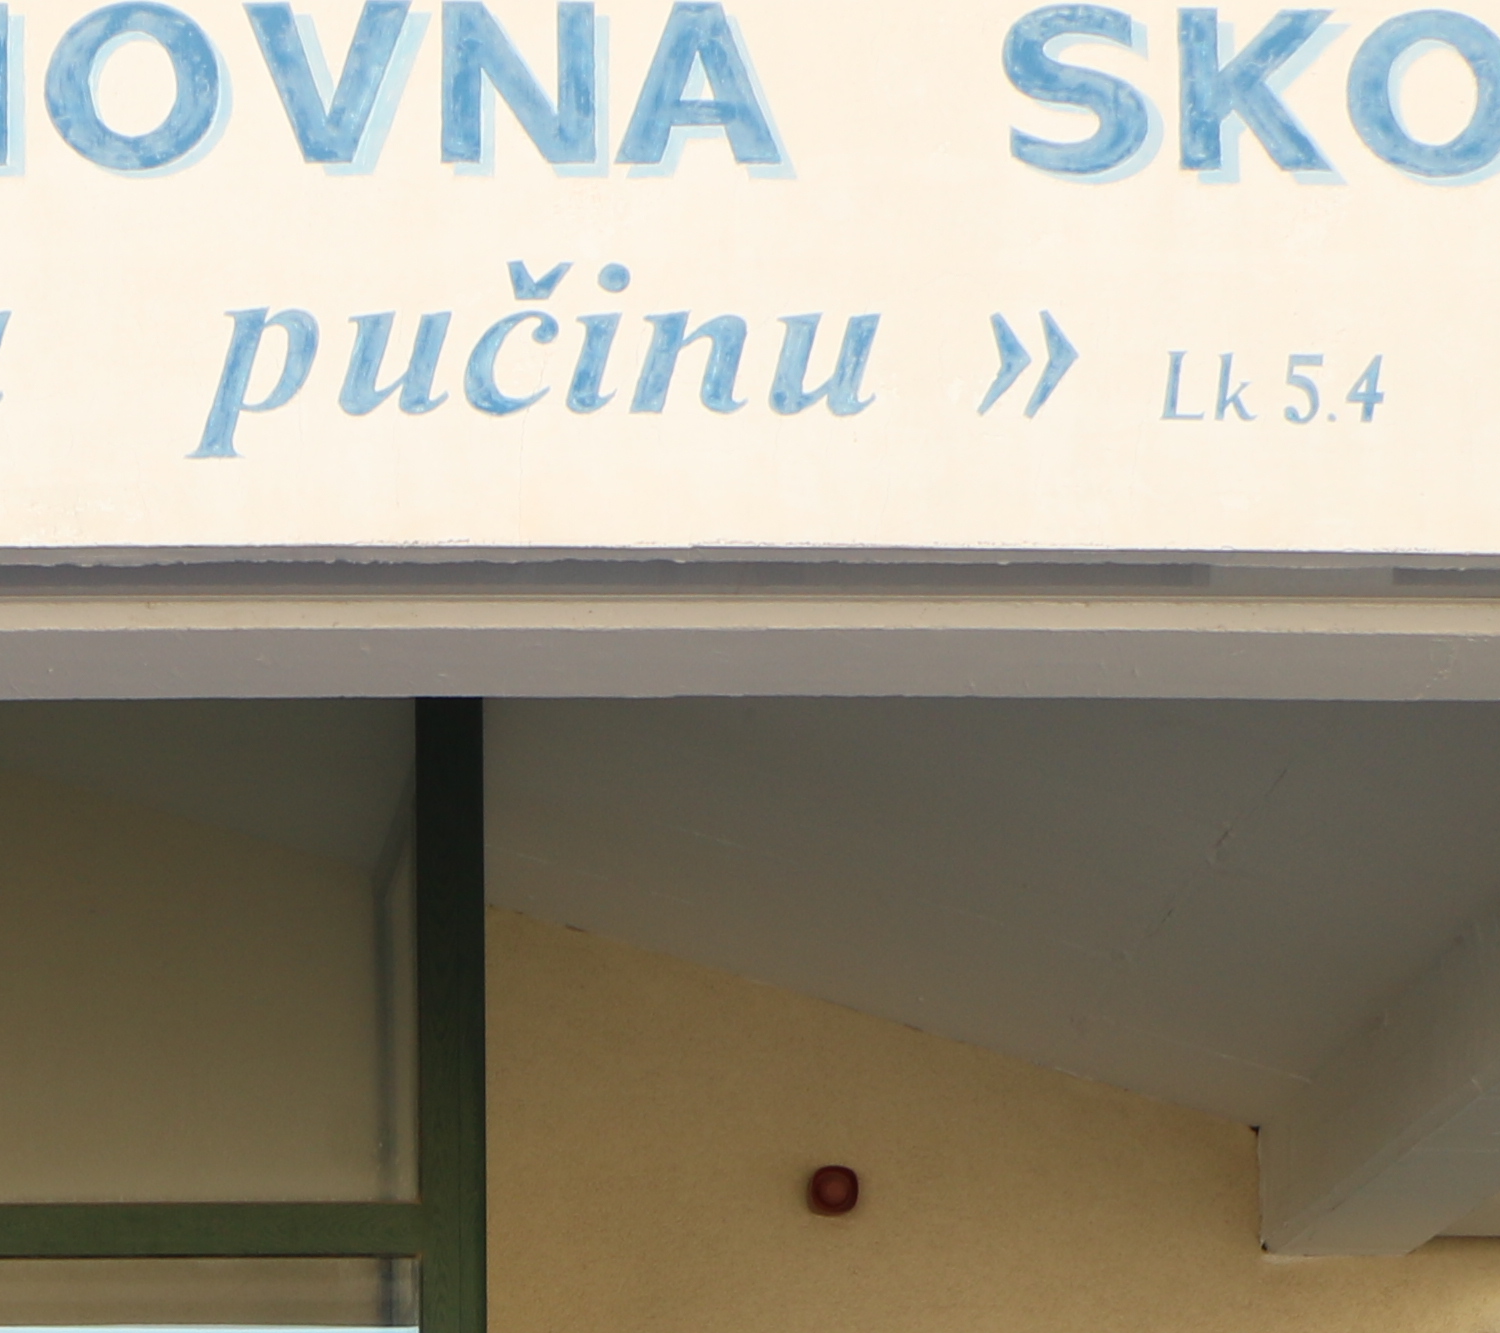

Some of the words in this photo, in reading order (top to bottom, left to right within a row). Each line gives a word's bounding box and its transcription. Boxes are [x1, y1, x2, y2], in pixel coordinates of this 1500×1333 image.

[184, 259, 884, 459] pučinu
[1159, 350, 1259, 421] Lk
[1283, 353, 1386, 425] 5.4
